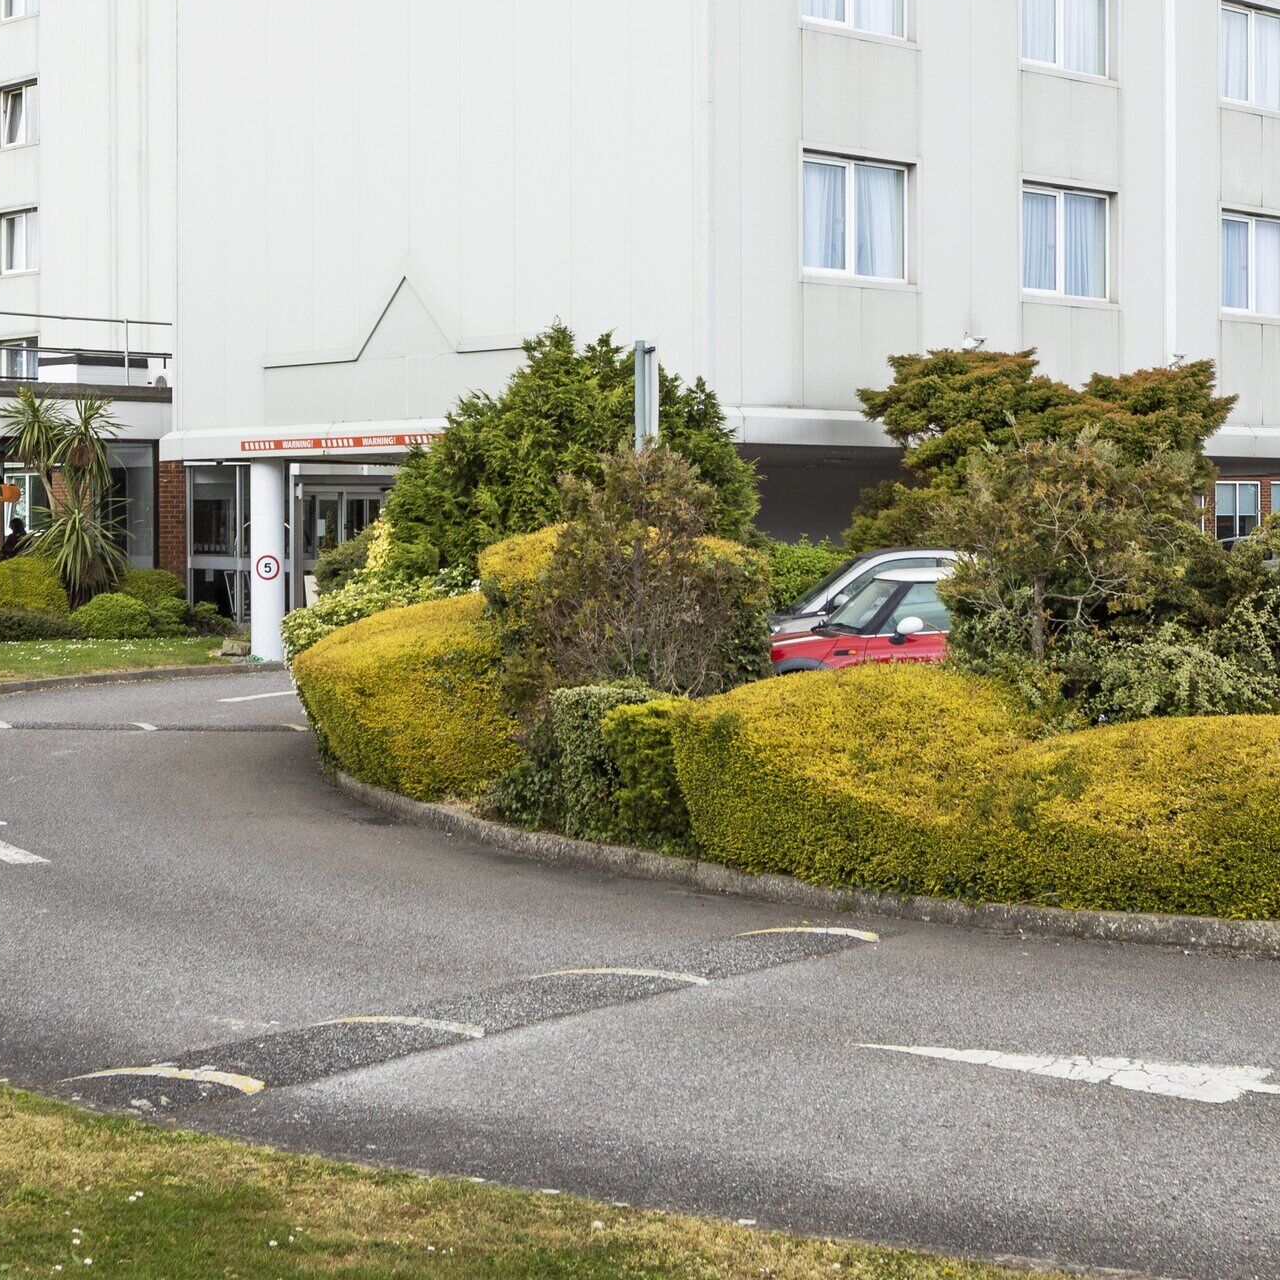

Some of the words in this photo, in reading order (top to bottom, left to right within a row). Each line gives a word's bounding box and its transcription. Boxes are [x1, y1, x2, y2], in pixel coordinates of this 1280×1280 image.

[282, 439, 314, 449] WARNING!
[361, 436, 397, 446] WARNING!
[264, 562, 272, 574] 5
